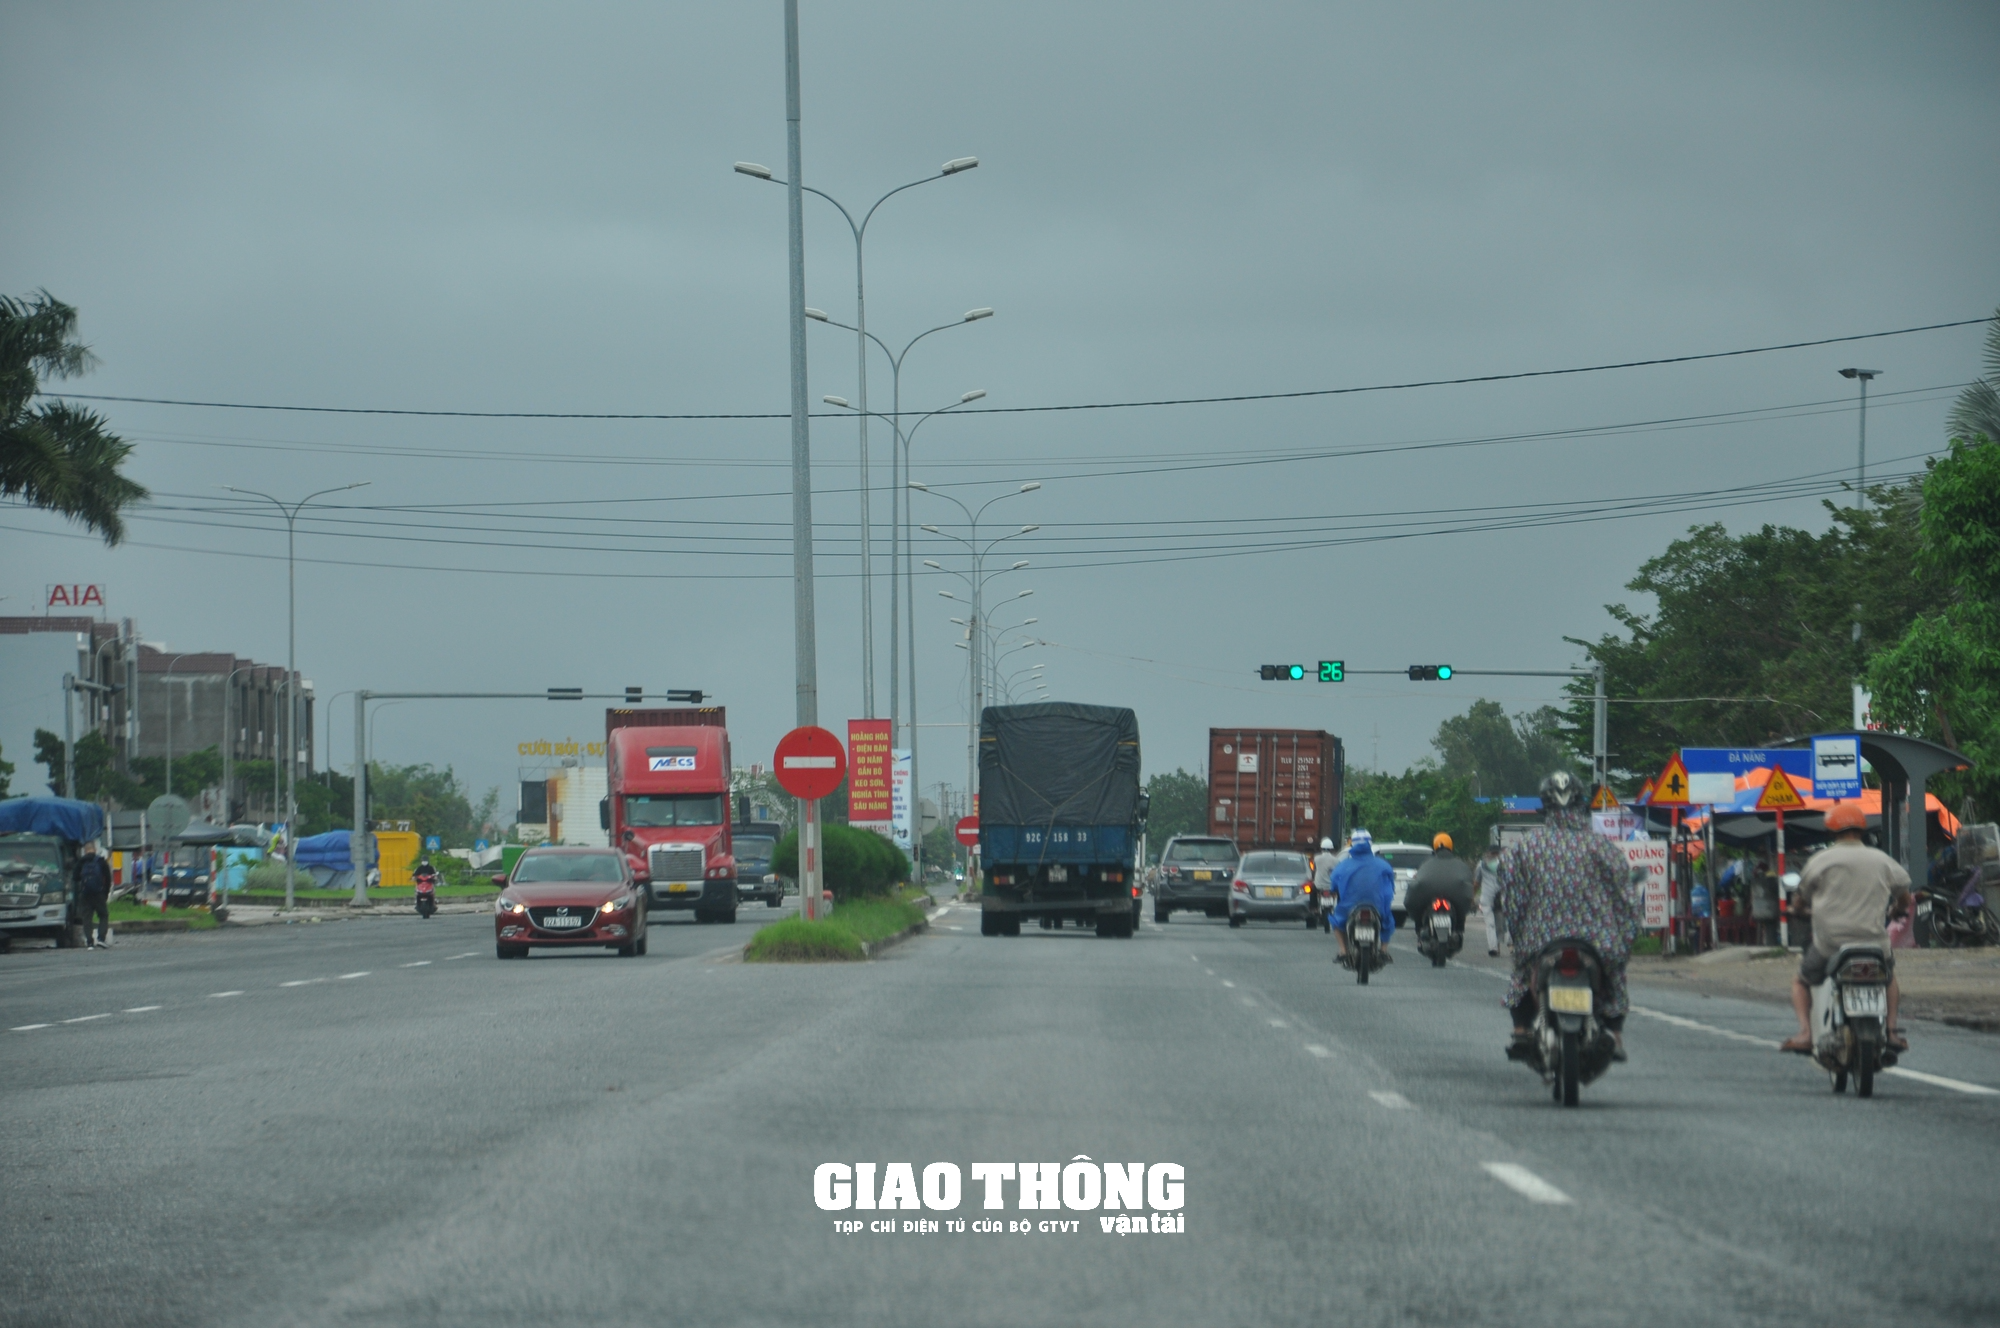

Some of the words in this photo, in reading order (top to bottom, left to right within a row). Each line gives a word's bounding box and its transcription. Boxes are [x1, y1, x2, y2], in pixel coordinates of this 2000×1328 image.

[48, 584, 103, 606] AIA
[1320, 662, 1343, 682] 26
[857, 756, 865, 764] 60
[1729, 751, 1741, 763] ĐÀ
[855, 779, 868, 787] KEO
[1026, 832, 1041, 842] 92C
[1053, 832, 1068, 842] 158
[1077, 832, 1087, 842] 33
[1628, 845, 1665, 861] QUẢNG
